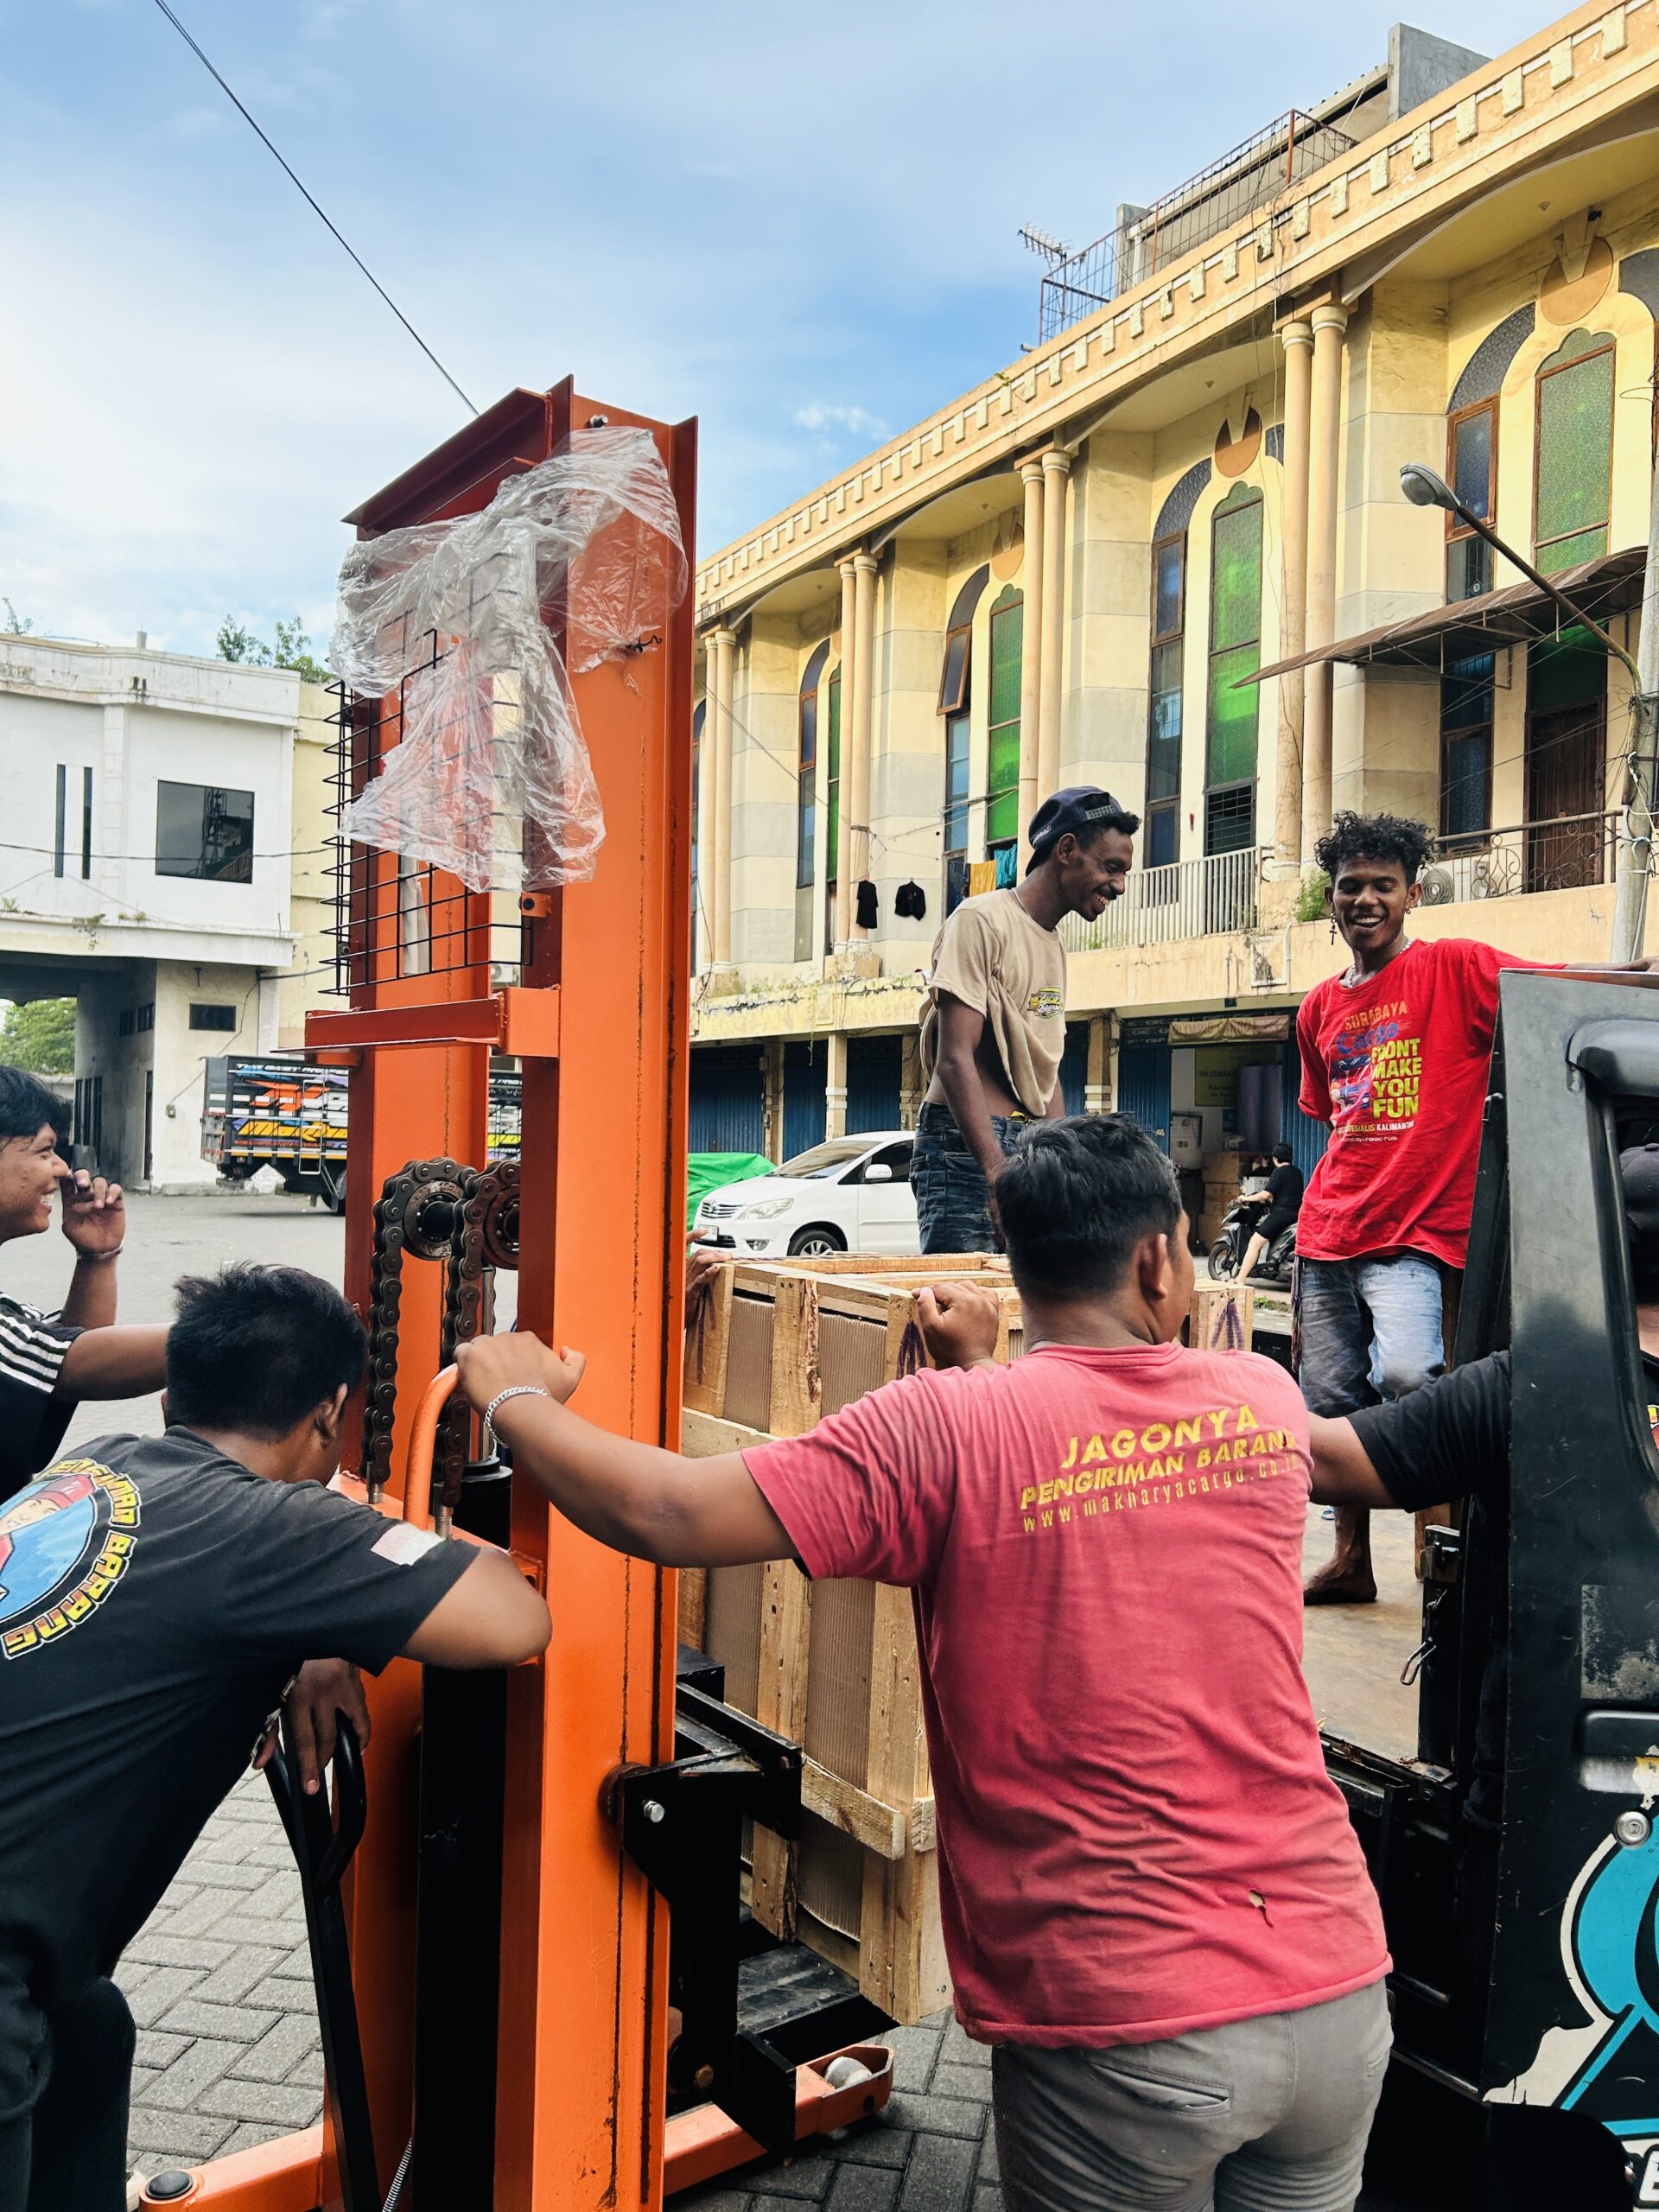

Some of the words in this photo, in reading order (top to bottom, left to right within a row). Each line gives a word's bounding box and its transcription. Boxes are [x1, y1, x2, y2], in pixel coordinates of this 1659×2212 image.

[1345, 1001, 1408, 1031] SURABAYA
[1372, 1058, 1421, 1079] MAKE
[1373, 1077, 1419, 1097] YOU
[1372, 1096, 1419, 1118] FUN
[1061, 1405, 1260, 1469] JAGONYA
[1020, 1453, 1184, 1510] PENGIRIMAN
[2, 1530, 136, 1658] BARANG
